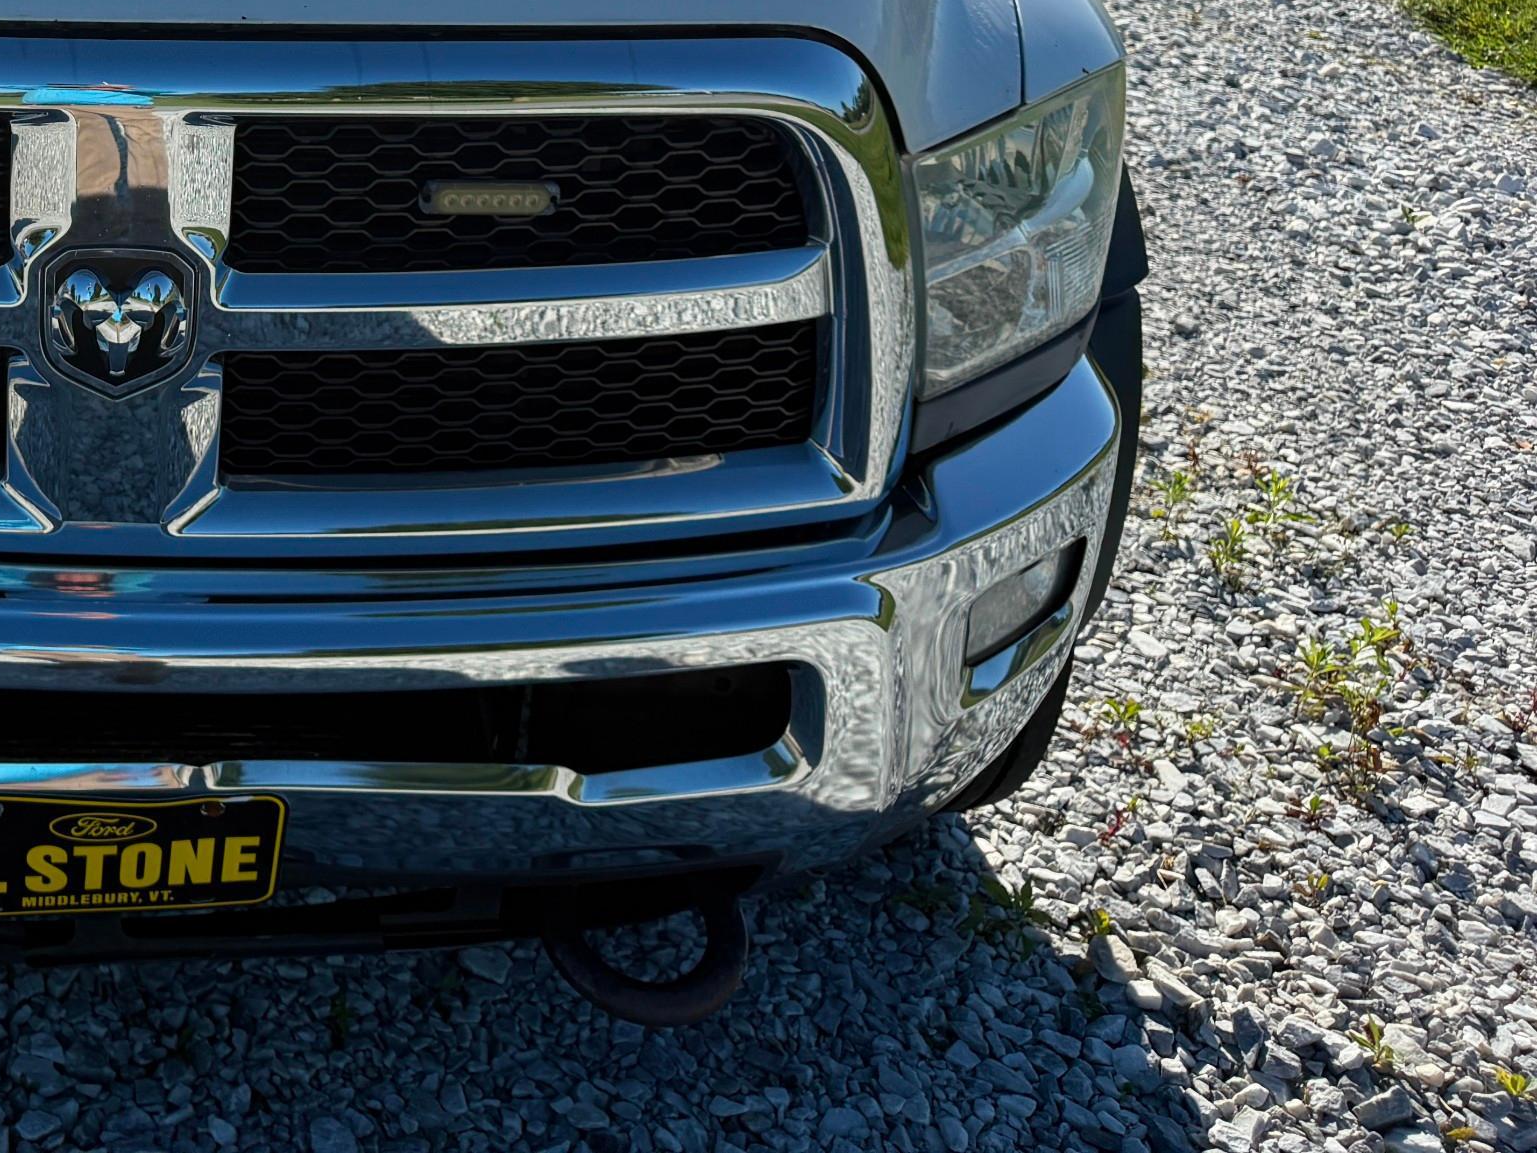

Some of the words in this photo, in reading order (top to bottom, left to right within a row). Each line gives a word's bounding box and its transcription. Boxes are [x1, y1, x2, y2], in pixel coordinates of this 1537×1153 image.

[70, 815, 136, 838] Ford
[24, 836, 261, 894] STONE
[148, 890, 175, 902] VT.
